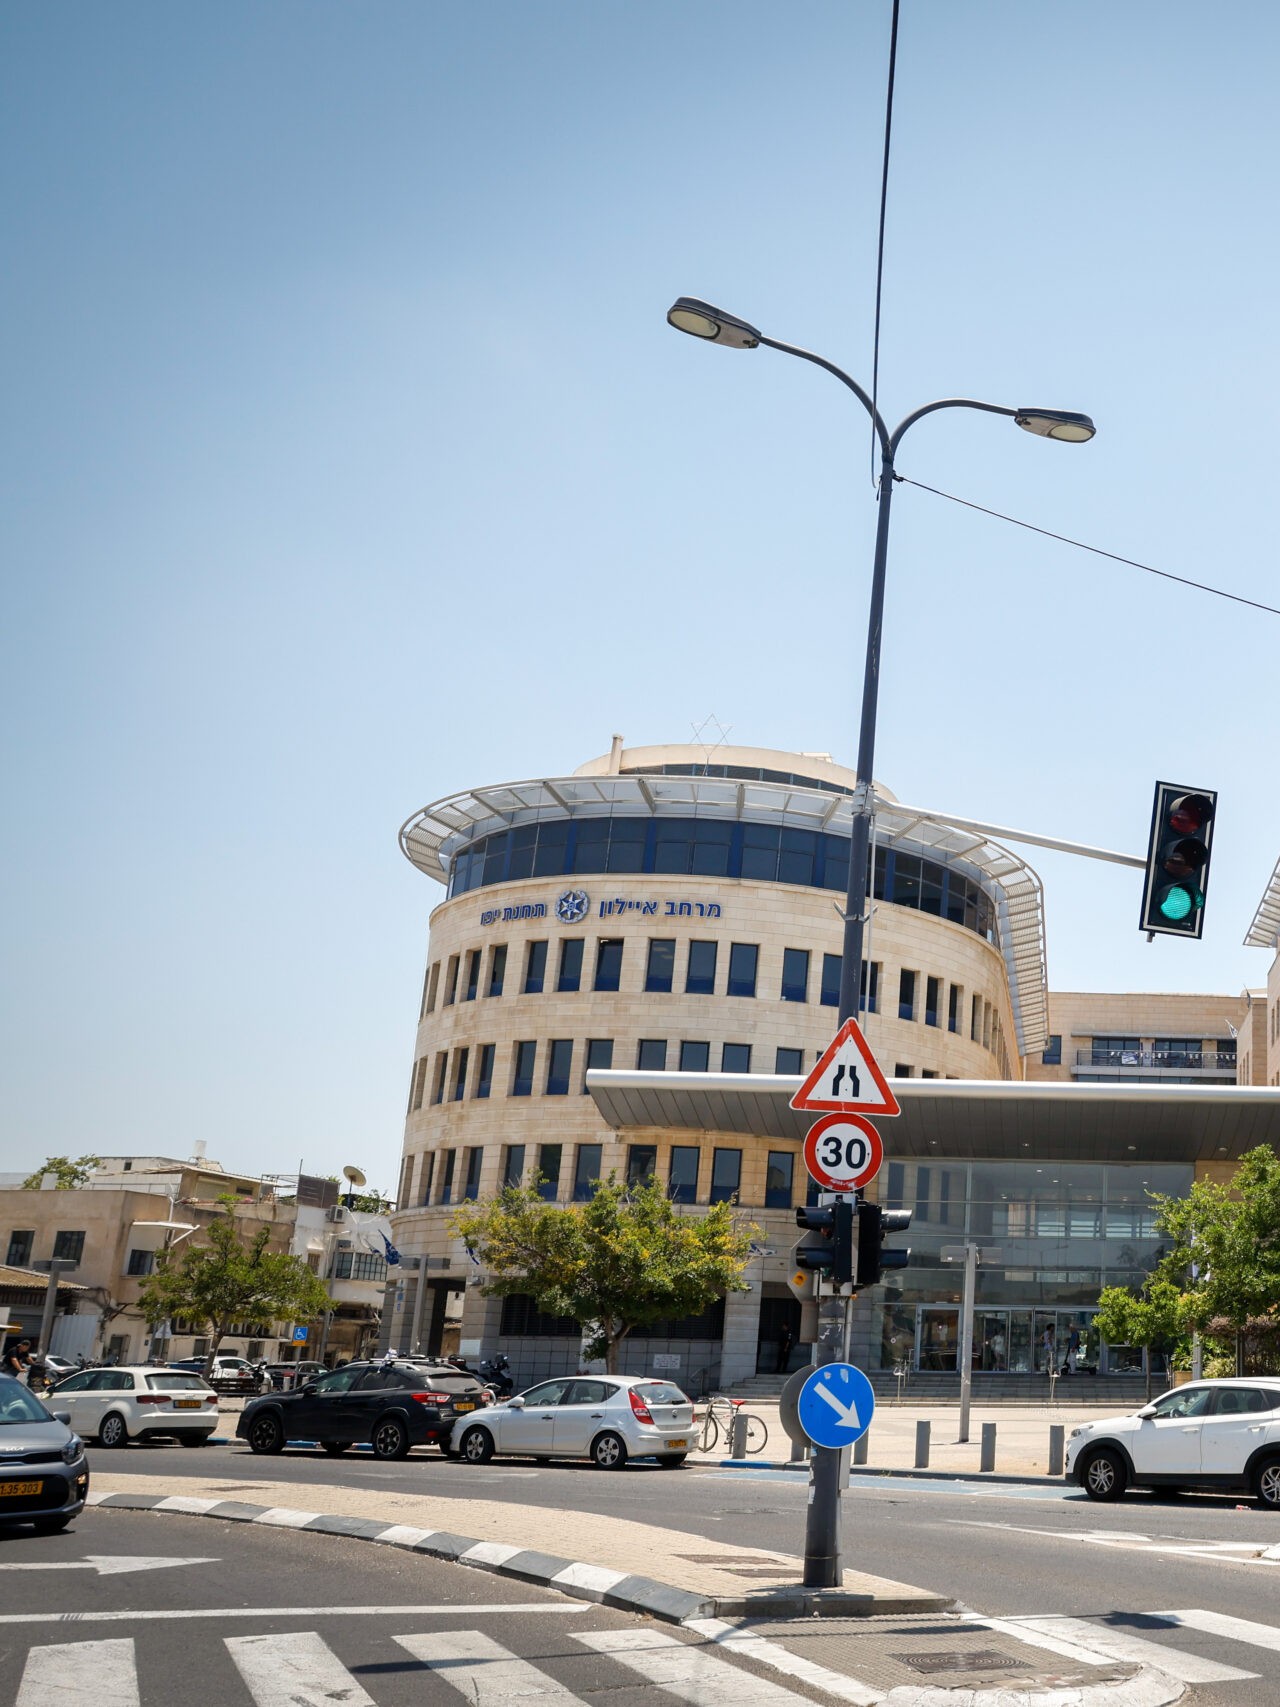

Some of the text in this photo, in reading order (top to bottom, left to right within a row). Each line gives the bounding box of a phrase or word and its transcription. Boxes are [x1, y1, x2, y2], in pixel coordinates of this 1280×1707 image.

[480, 903, 545, 925] תחנת יפו
[599, 898, 721, 918] מרחב איילון
[821, 1136, 867, 1170] 30
